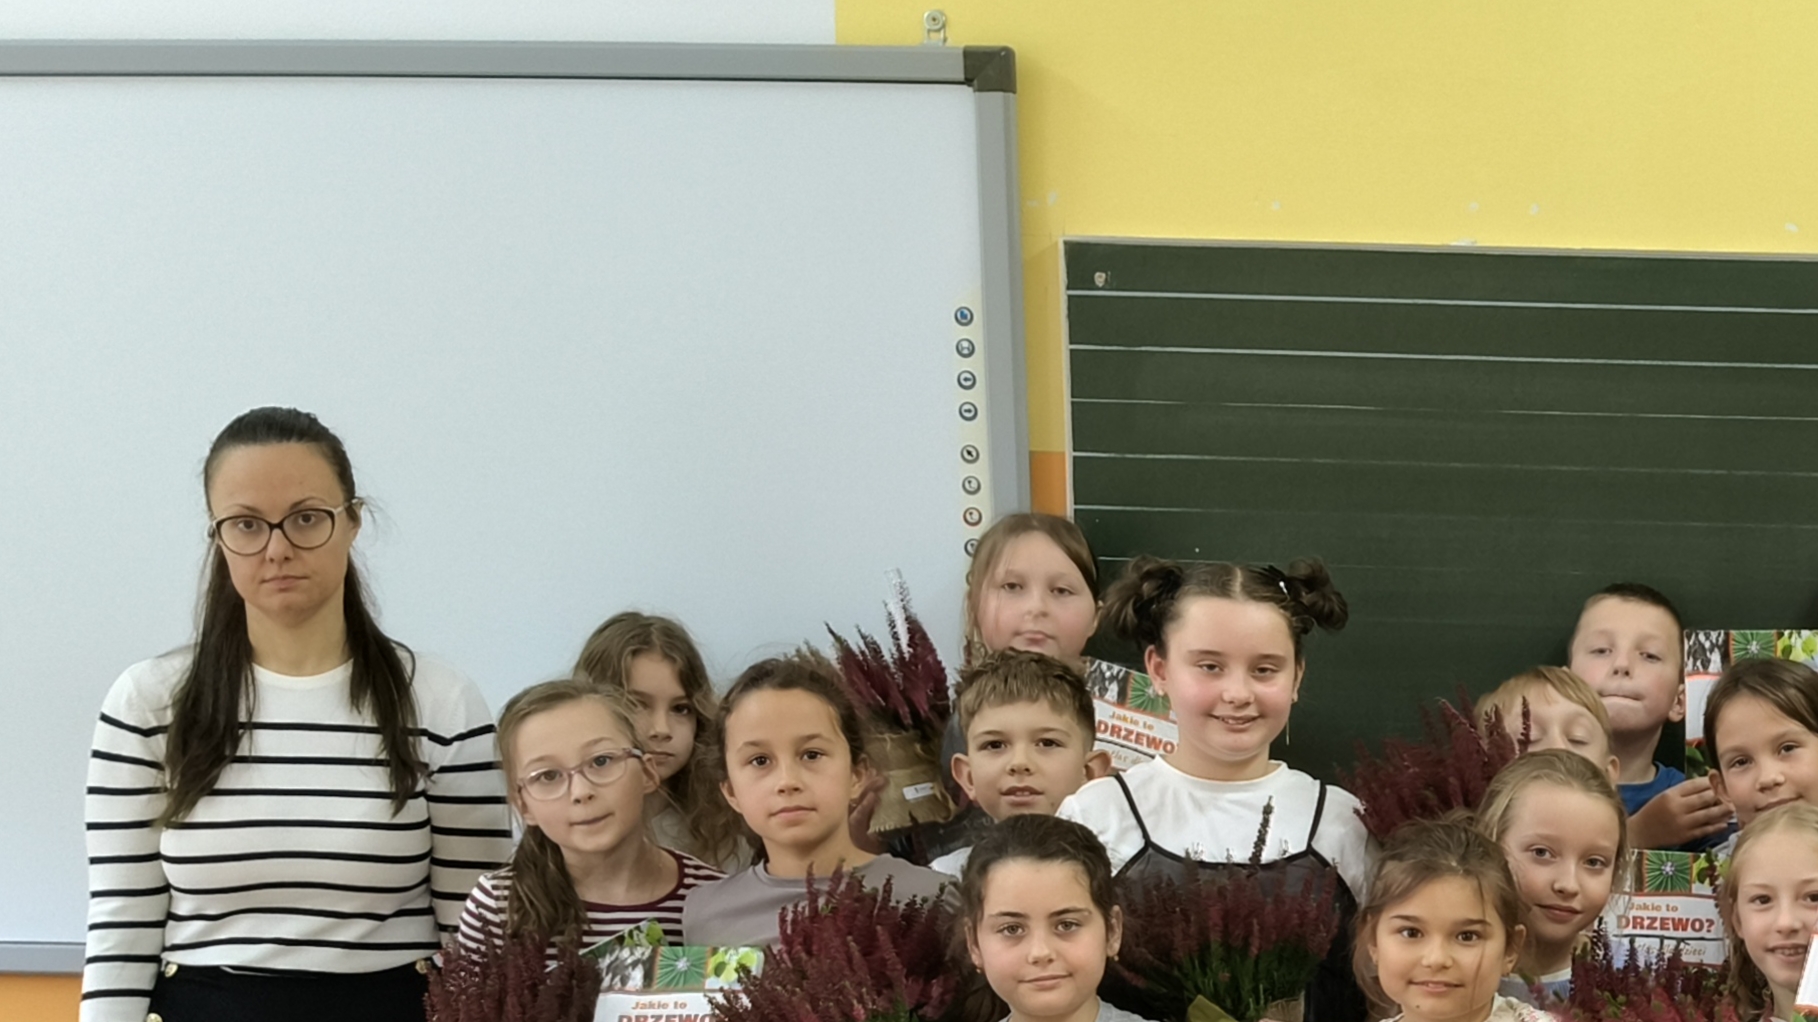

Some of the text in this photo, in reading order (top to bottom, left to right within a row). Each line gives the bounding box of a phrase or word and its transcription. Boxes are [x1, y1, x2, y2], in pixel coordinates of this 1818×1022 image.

[1096, 719, 1177, 755] DRZEWO
[1629, 902, 1679, 912] Jakie to
[1617, 915, 1716, 933] DRZEWO?
[631, 1000, 688, 1010] Jakie to
